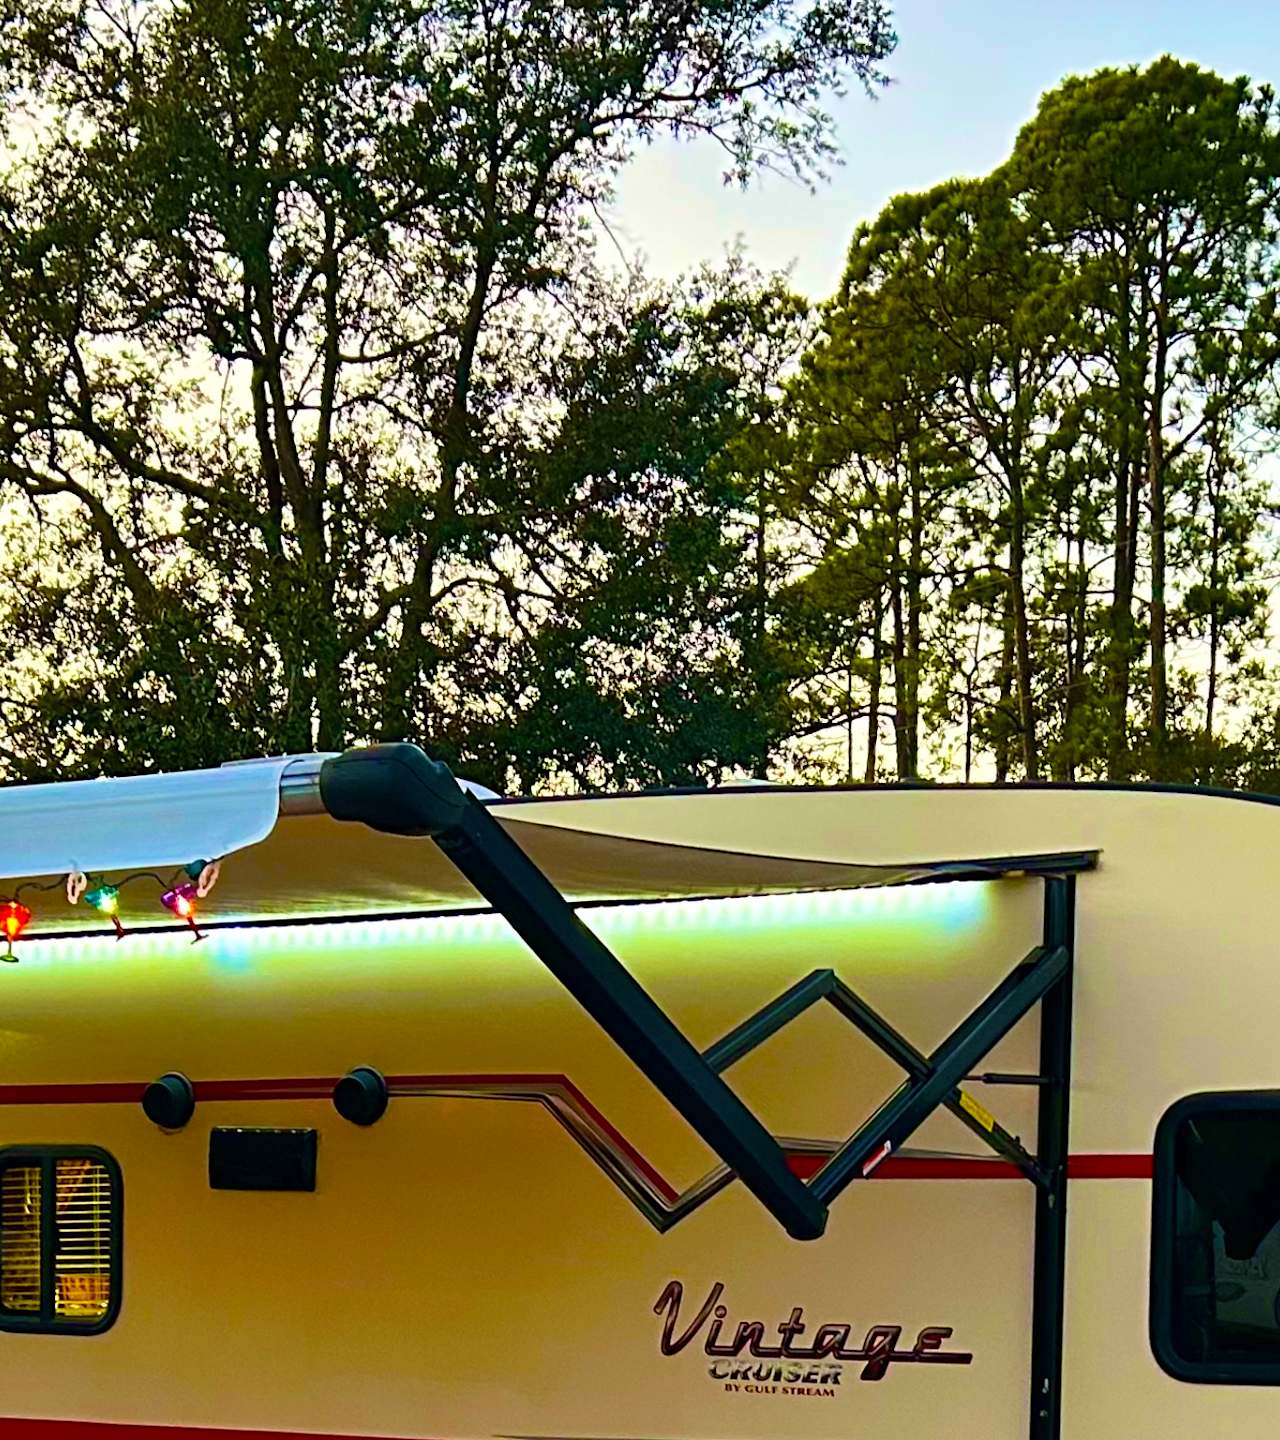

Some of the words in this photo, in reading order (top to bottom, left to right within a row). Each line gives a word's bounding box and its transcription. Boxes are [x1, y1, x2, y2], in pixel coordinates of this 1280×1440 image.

[652, 1280, 974, 1381] Vintage
[708, 1359, 843, 1385] CRUISER
[724, 1383, 742, 1392] BY
[745, 1384, 778, 1394] GULF
[781, 1386, 835, 1397] STREAM
